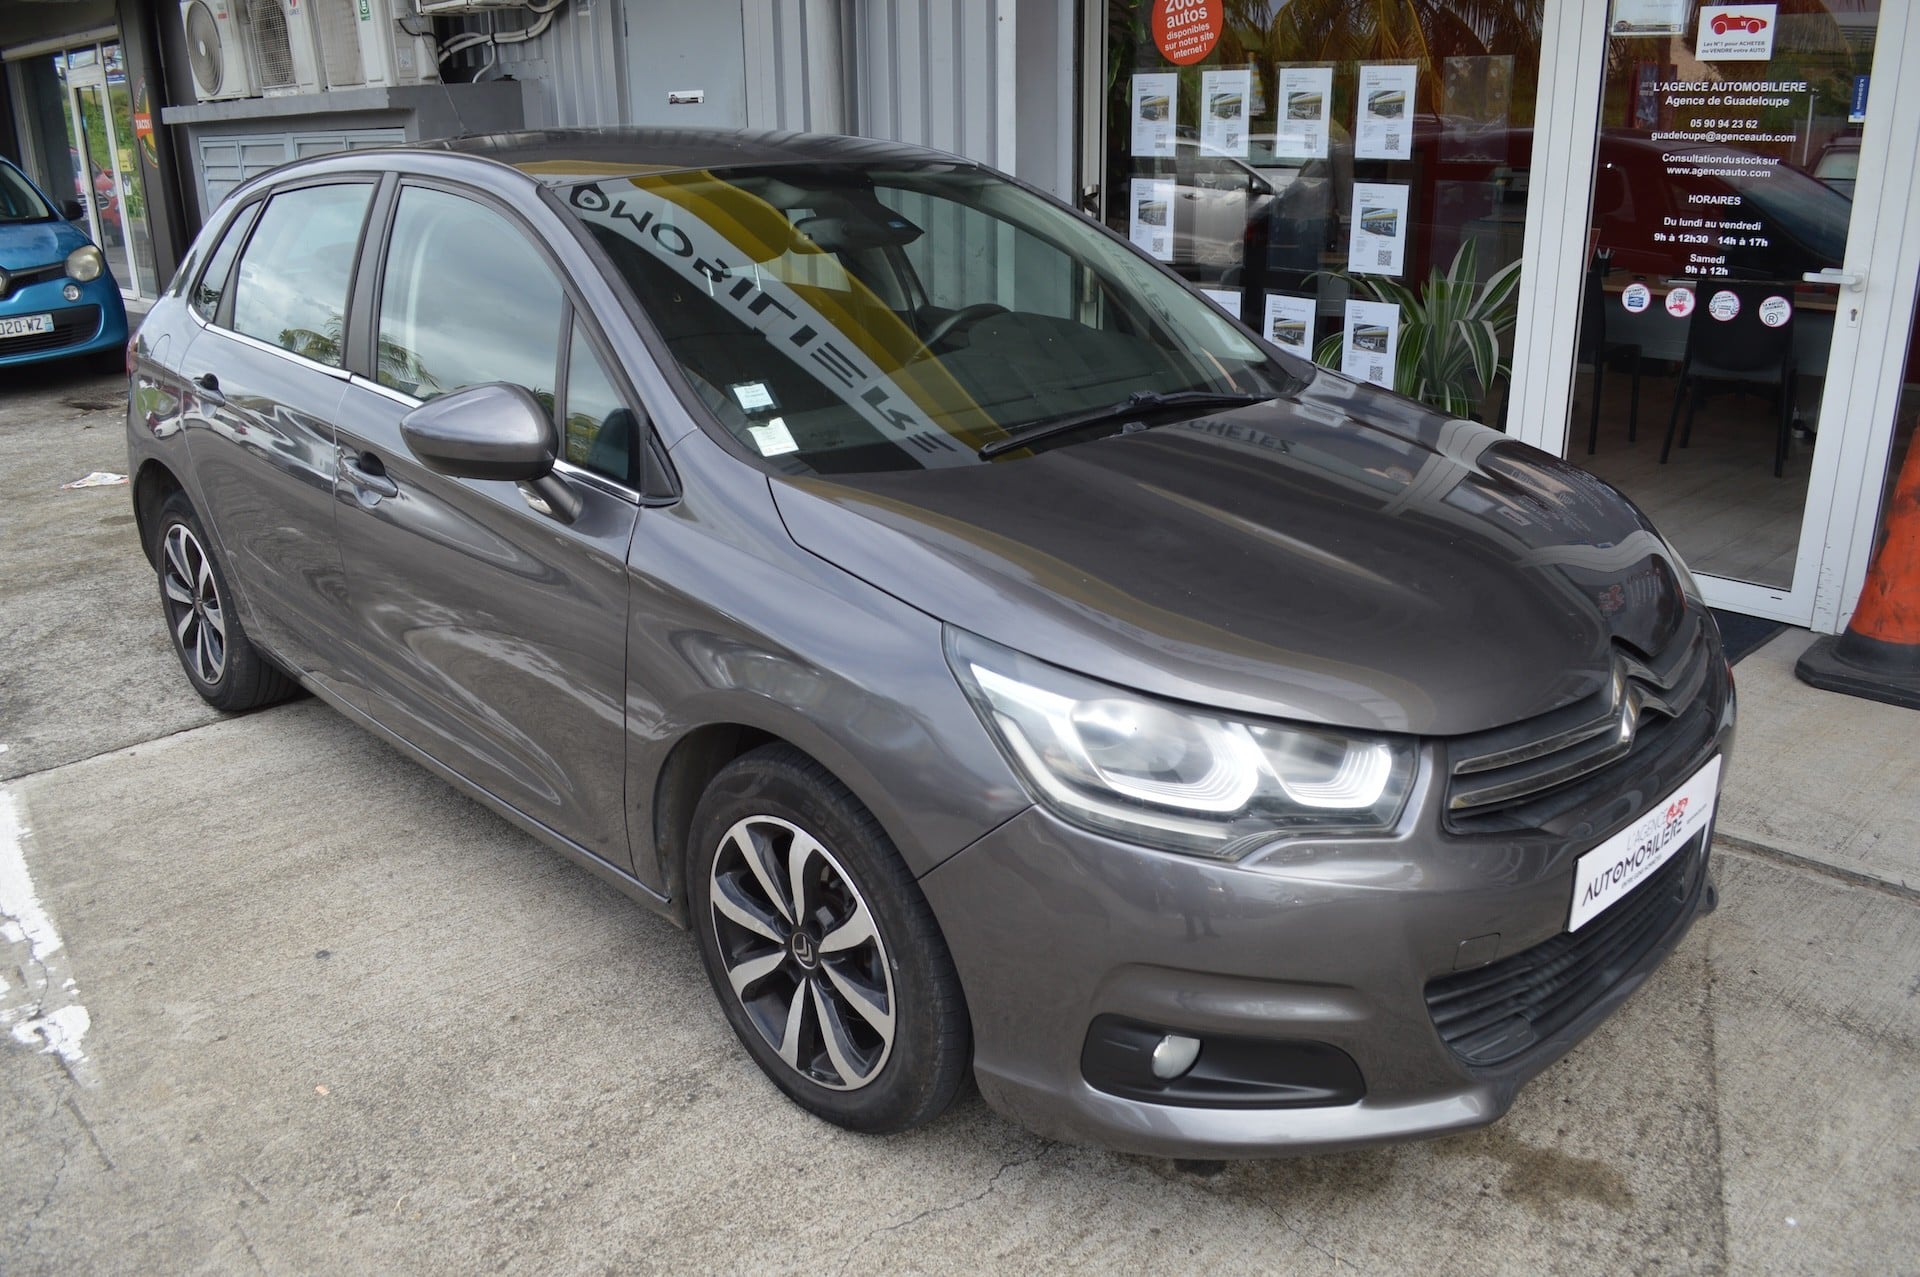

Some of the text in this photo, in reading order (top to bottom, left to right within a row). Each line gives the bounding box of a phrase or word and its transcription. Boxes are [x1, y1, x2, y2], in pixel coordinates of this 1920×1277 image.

[1165, 0, 1205, 14] 20
[1166, 6, 1208, 29] autos
[1166, 22, 1210, 40] disponibles
[1164, 32, 1214, 51] sur notre site
[1173, 45, 1203, 59] internet
[1653, 82, 1808, 92] L'AGENCE AUTOMOBILIERE
[1665, 95, 1790, 108] Agence de Guadeloupe
[1690, 119, 1758, 129] 05 90 94 23 62
[1651, 131, 1797, 143] guadeloupe@agenceauto.com
[1666, 167, 1771, 178] www.agenceauto.com
[1688, 194, 1742, 206] HORAIRES
[1664, 217, 1677, 226] Du
[1679, 217, 1703, 228] lundi
[1719, 220, 1762, 231] vendredi
[1654, 233, 1768, 247] 9h à 12h30 14h à 17h
[1690, 253, 1726, 264] Samedi
[1685, 265, 1729, 276] 9h à 12h
[1582, 819, 1684, 907] AUTOMOBILIERE
